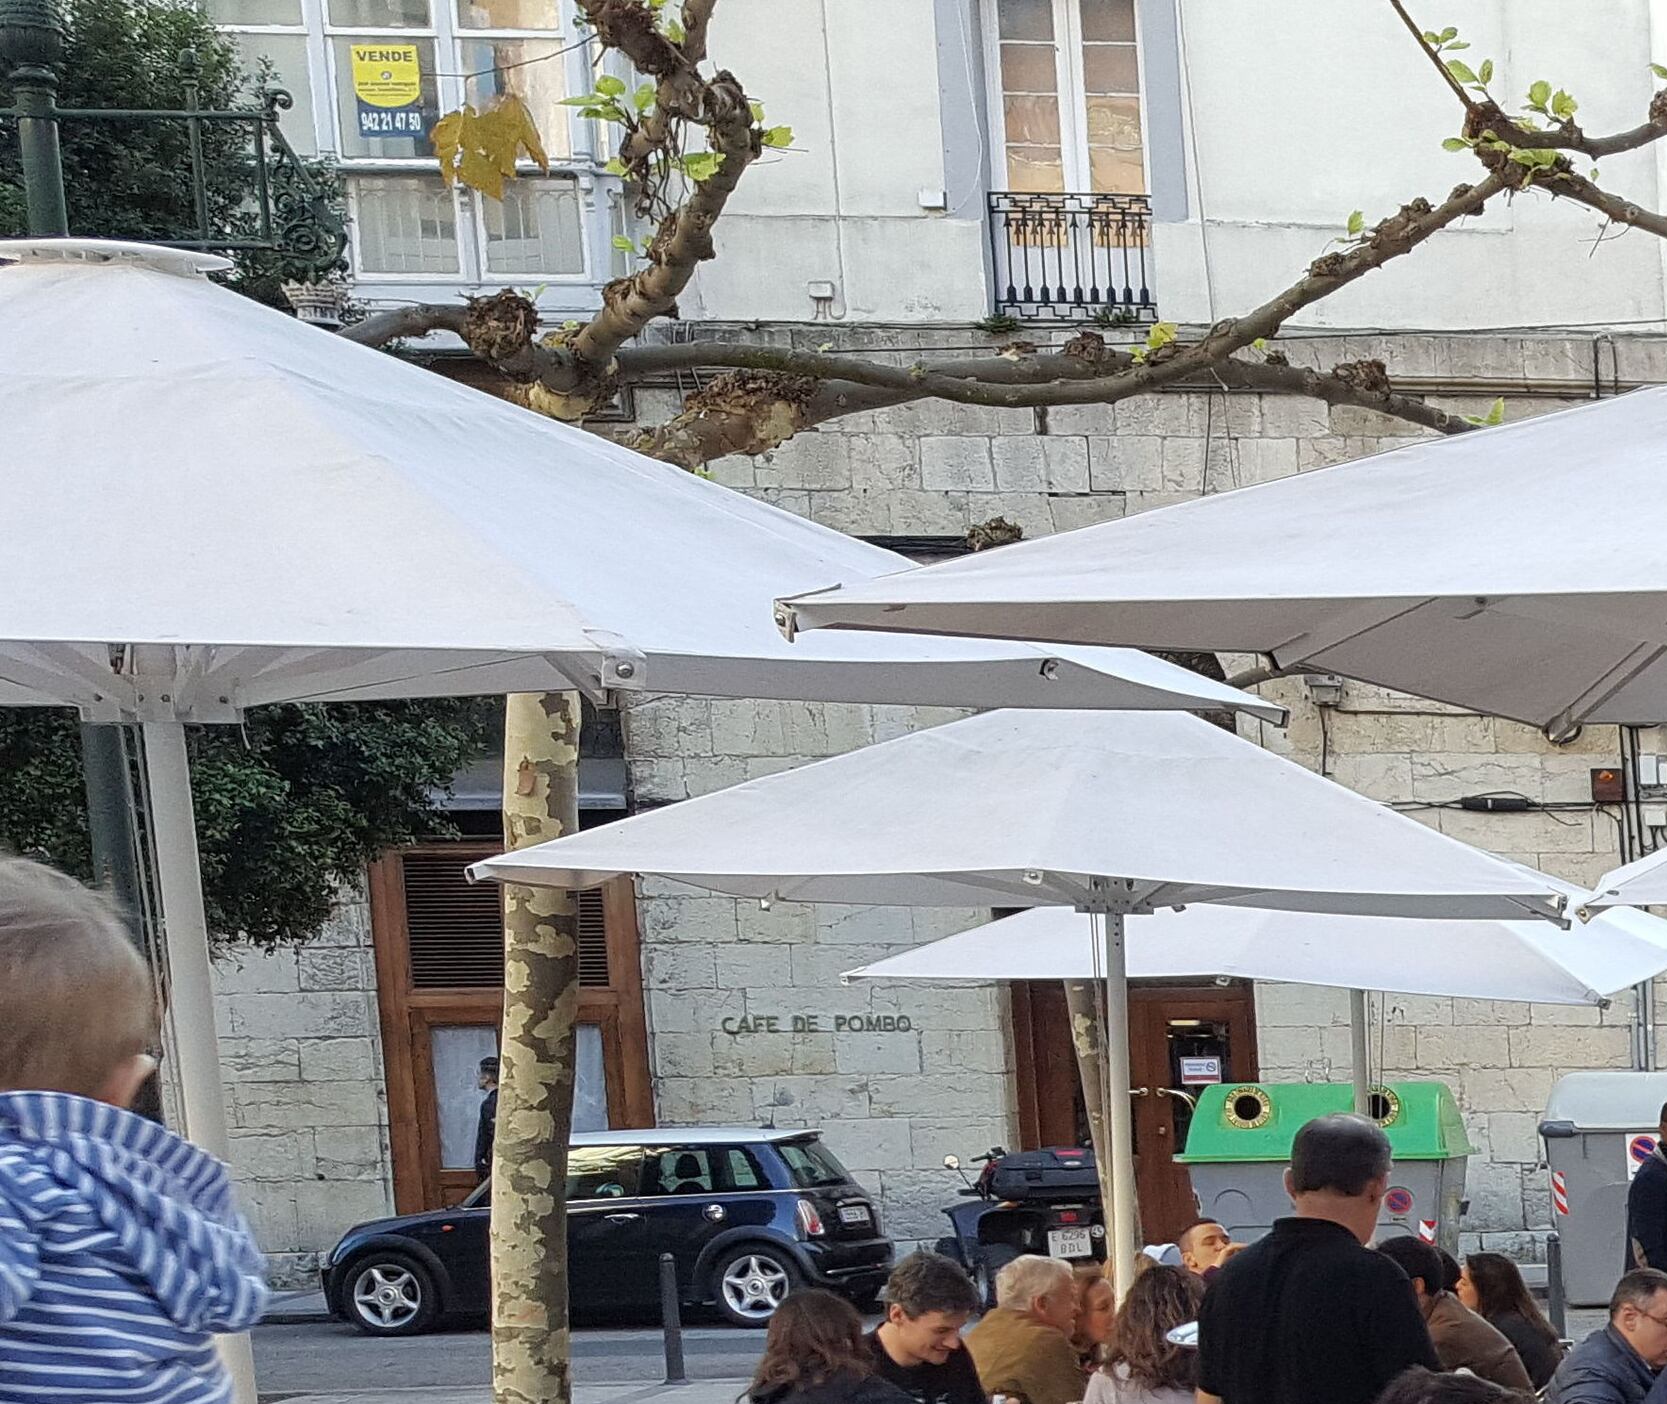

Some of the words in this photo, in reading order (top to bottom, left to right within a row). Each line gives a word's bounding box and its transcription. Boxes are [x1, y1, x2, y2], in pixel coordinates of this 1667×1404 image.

[356, 51, 413, 62] VENDE
[361, 112, 380, 131] 942
[380, 112, 393, 131] 21
[395, 112, 406, 131] 47
[408, 112, 421, 131] 50
[721, 1015, 779, 1034] CAFE
[792, 1015, 819, 1033] DE
[835, 1014, 912, 1033] POMBO
